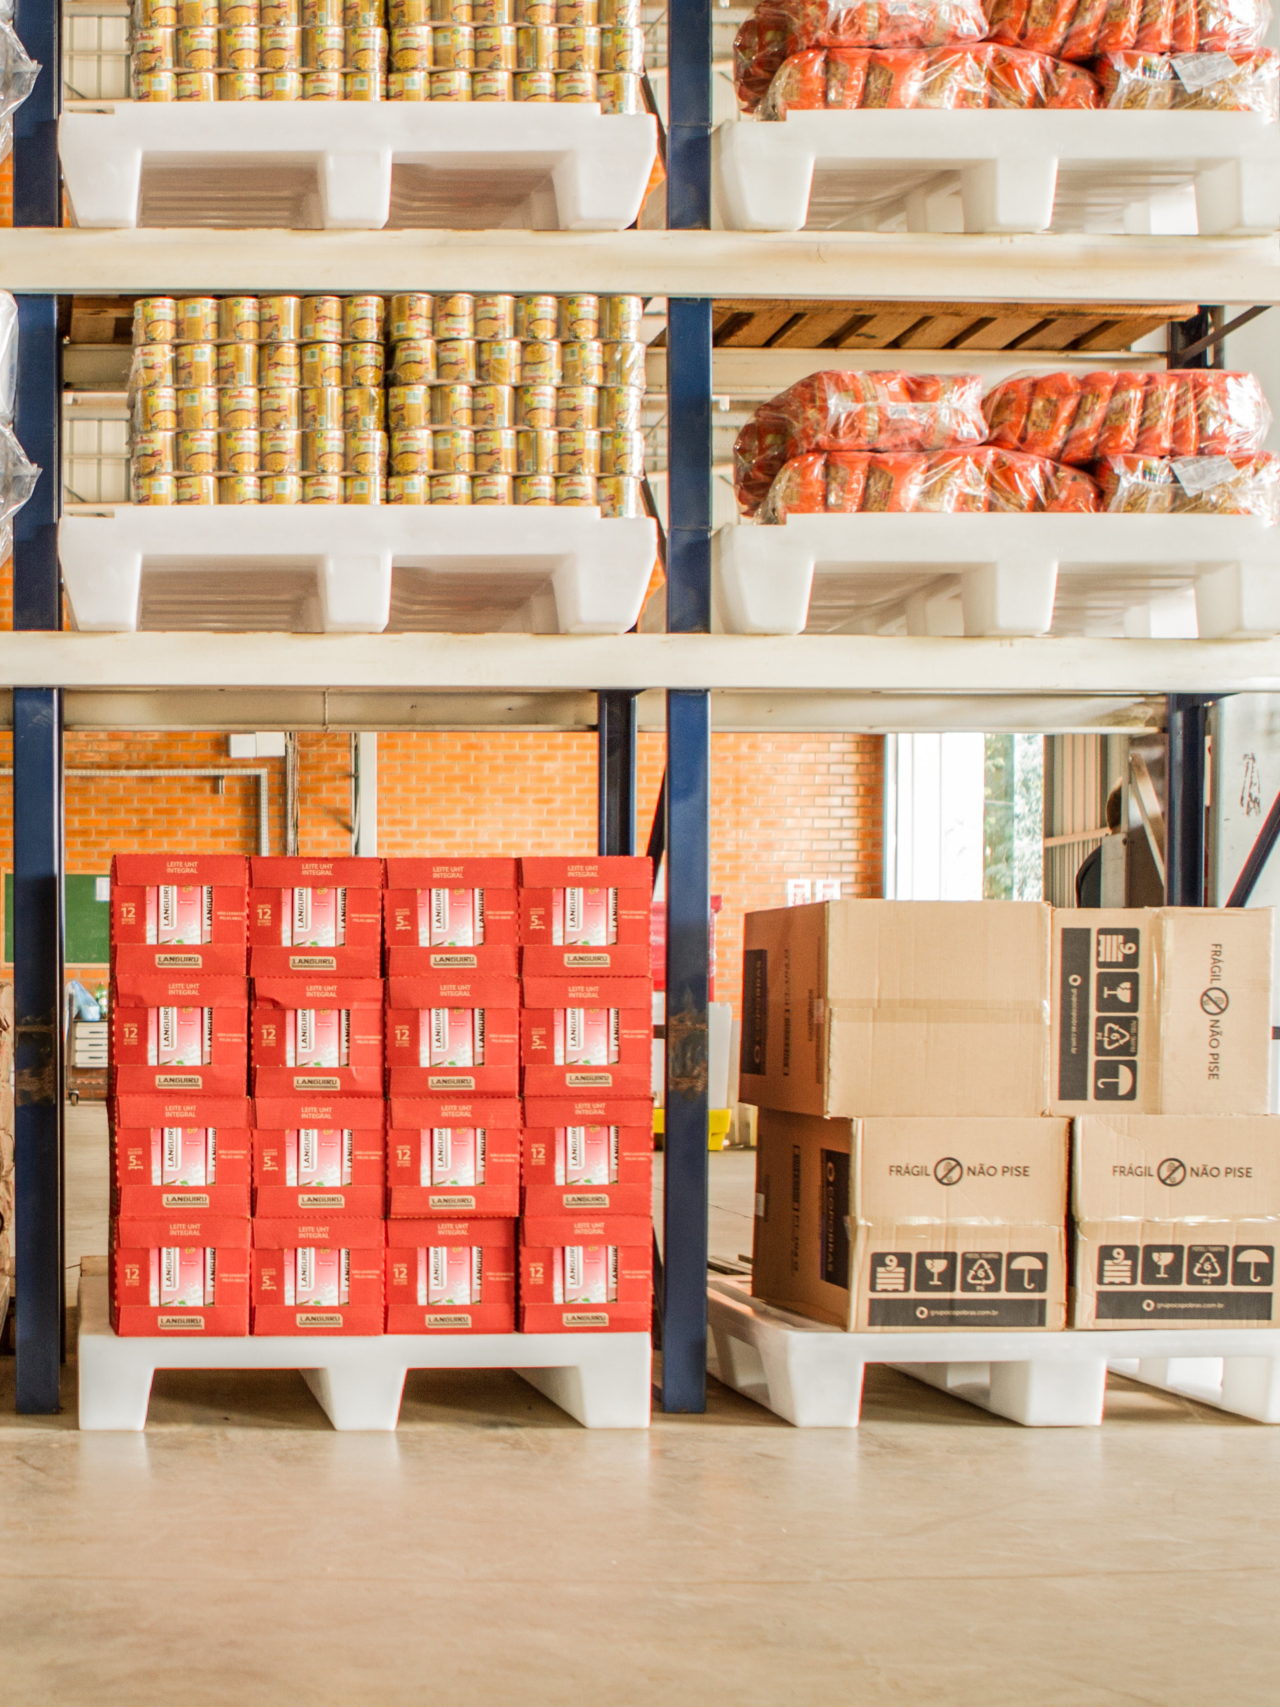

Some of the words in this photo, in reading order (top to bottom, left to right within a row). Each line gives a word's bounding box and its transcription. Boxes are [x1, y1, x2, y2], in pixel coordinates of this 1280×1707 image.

[121, 907, 136, 917] 12
[257, 909, 271, 919] 12
[1210, 944, 1224, 984] FRÁGIL
[123, 1028, 138, 1038] 12
[261, 1029, 276, 1039] 12
[395, 1030, 410, 1040] 12
[1208, 1019, 1221, 1049] NÃO
[1208, 1052, 1220, 1080] PISE
[396, 1150, 411, 1160] 12
[531, 1148, 545, 1158] 12
[889, 1164, 930, 1177] FRÁGIL
[967, 1164, 998, 1177] NÃO
[1002, 1165, 1030, 1177] PISE
[1112, 1164, 1153, 1177] FRÁGIL
[1190, 1164, 1220, 1178] NÃO
[1224, 1166, 1252, 1178] PISE
[1112, 1248, 1125, 1264] 9
[885, 1255, 898, 1272] 9
[1203, 1262, 1212, 1270] 6
[125, 1269, 139, 1279] 12
[393, 1268, 408, 1278] 12
[529, 1267, 544, 1277] 12
[977, 1269, 985, 1277] 6
